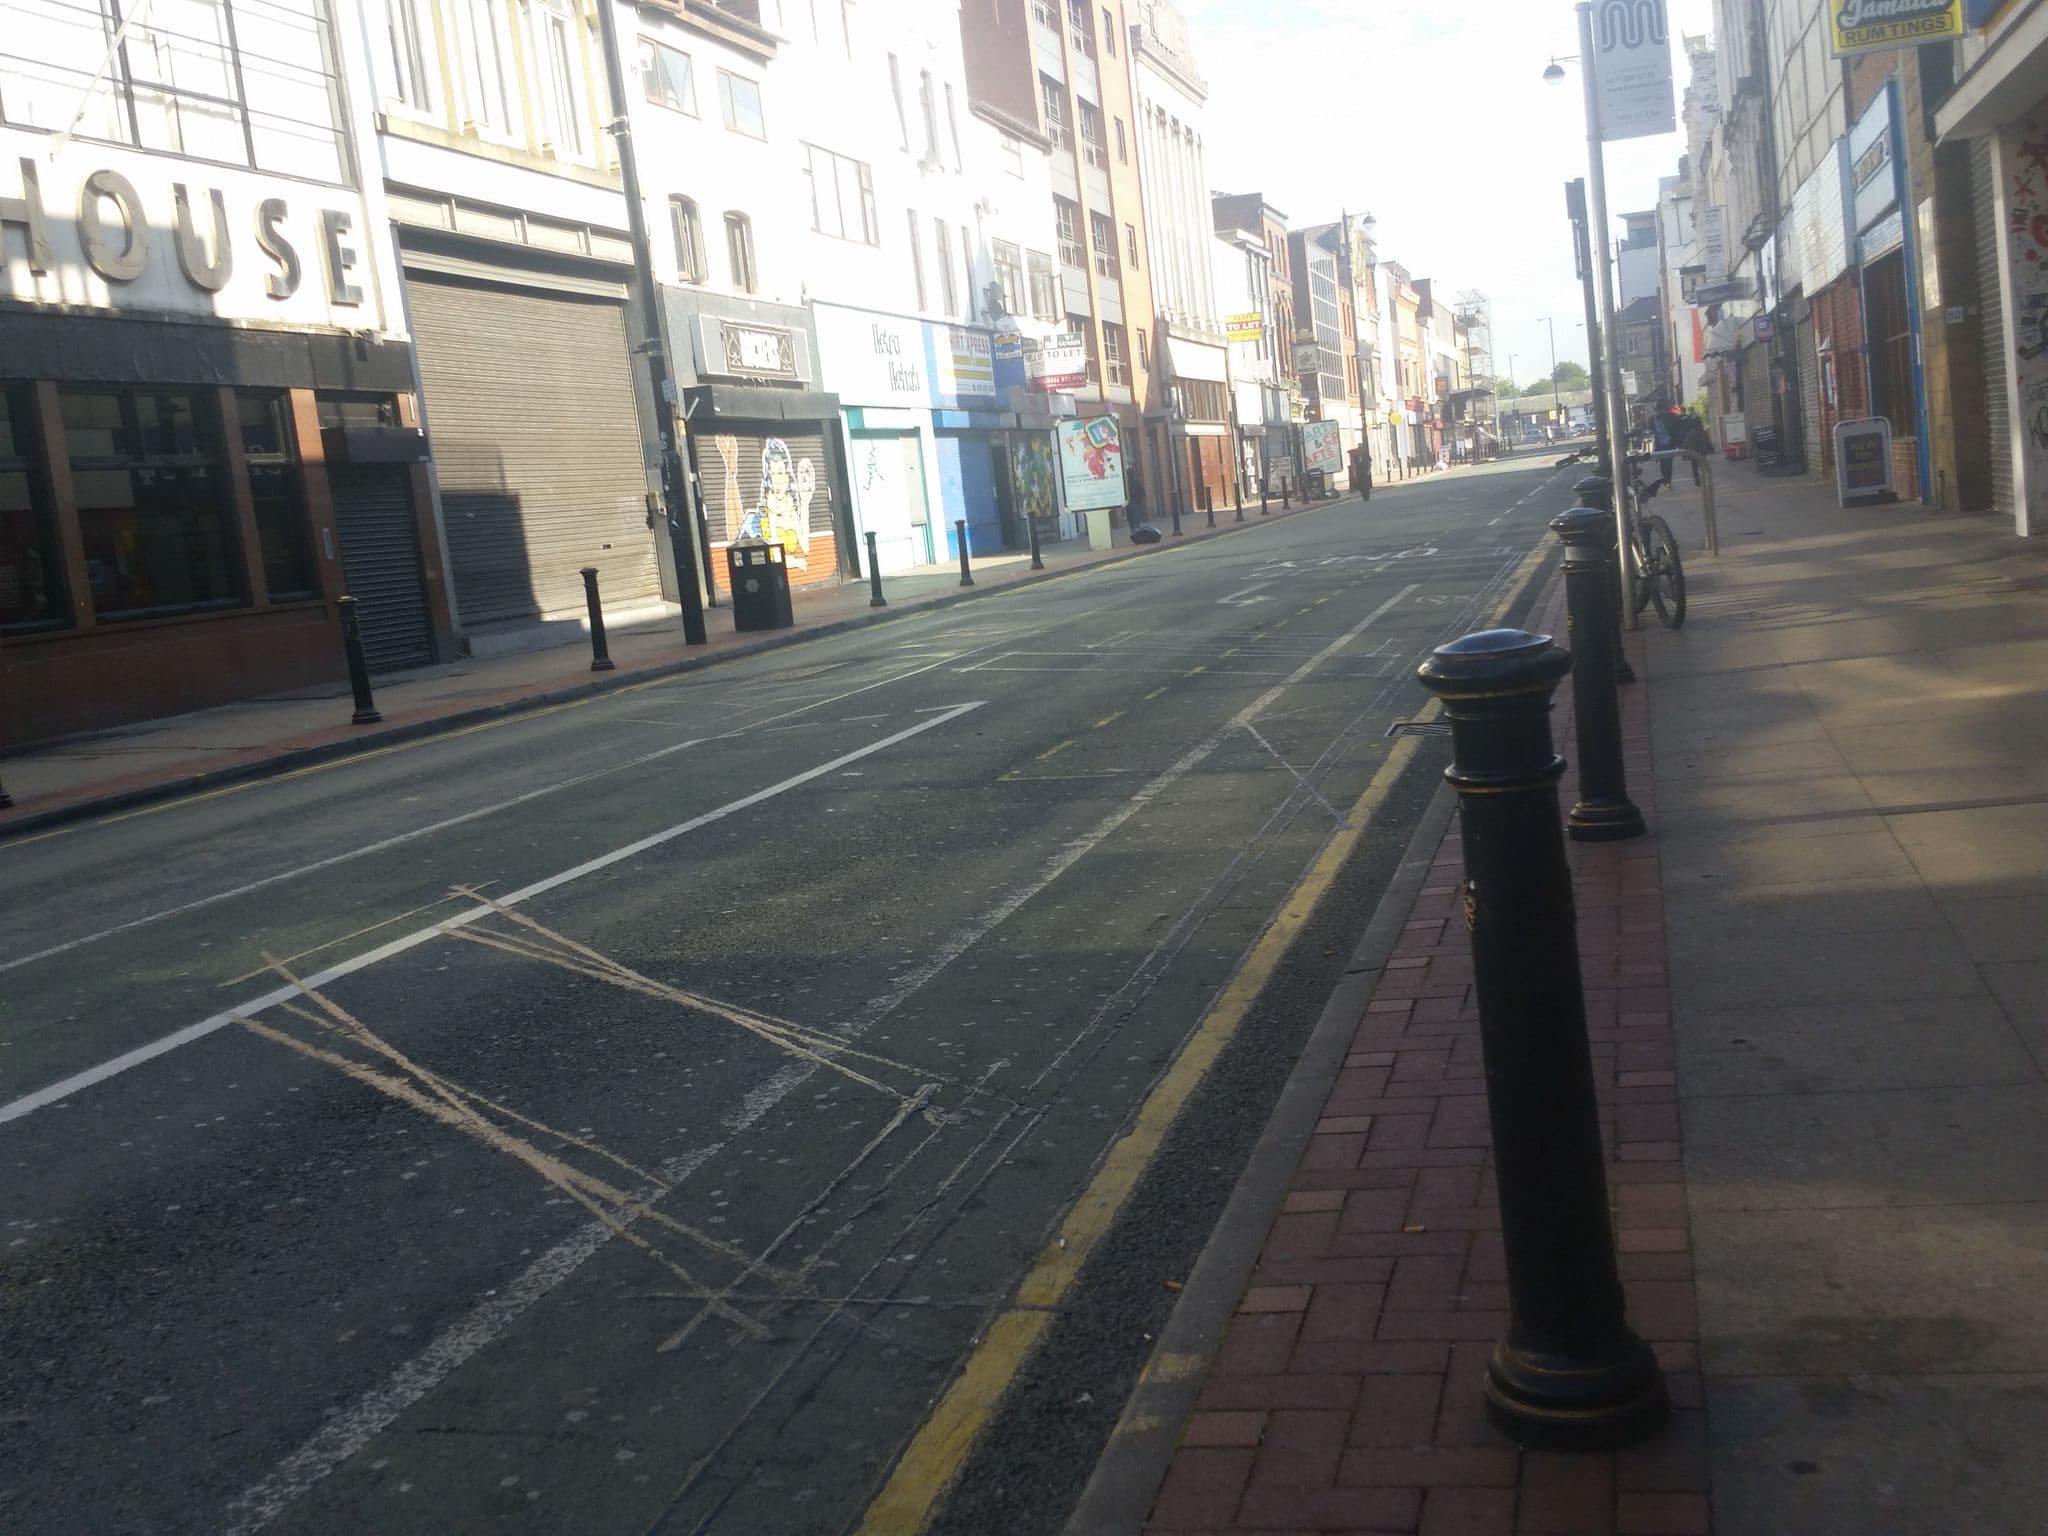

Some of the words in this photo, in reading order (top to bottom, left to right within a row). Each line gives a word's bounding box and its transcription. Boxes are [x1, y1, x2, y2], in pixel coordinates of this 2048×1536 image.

[1845, 25, 1886, 44] RUM
[1890, 16, 1946, 37] TINGS
[0, 157, 364, 308] HOUSE
[1226, 323, 1241, 331] TO
[1242, 320, 1260, 330] LET
[1047, 351, 1060, 359] TO
[1063, 349, 1081, 358] LET
[1314, 439, 1323, 448] &
